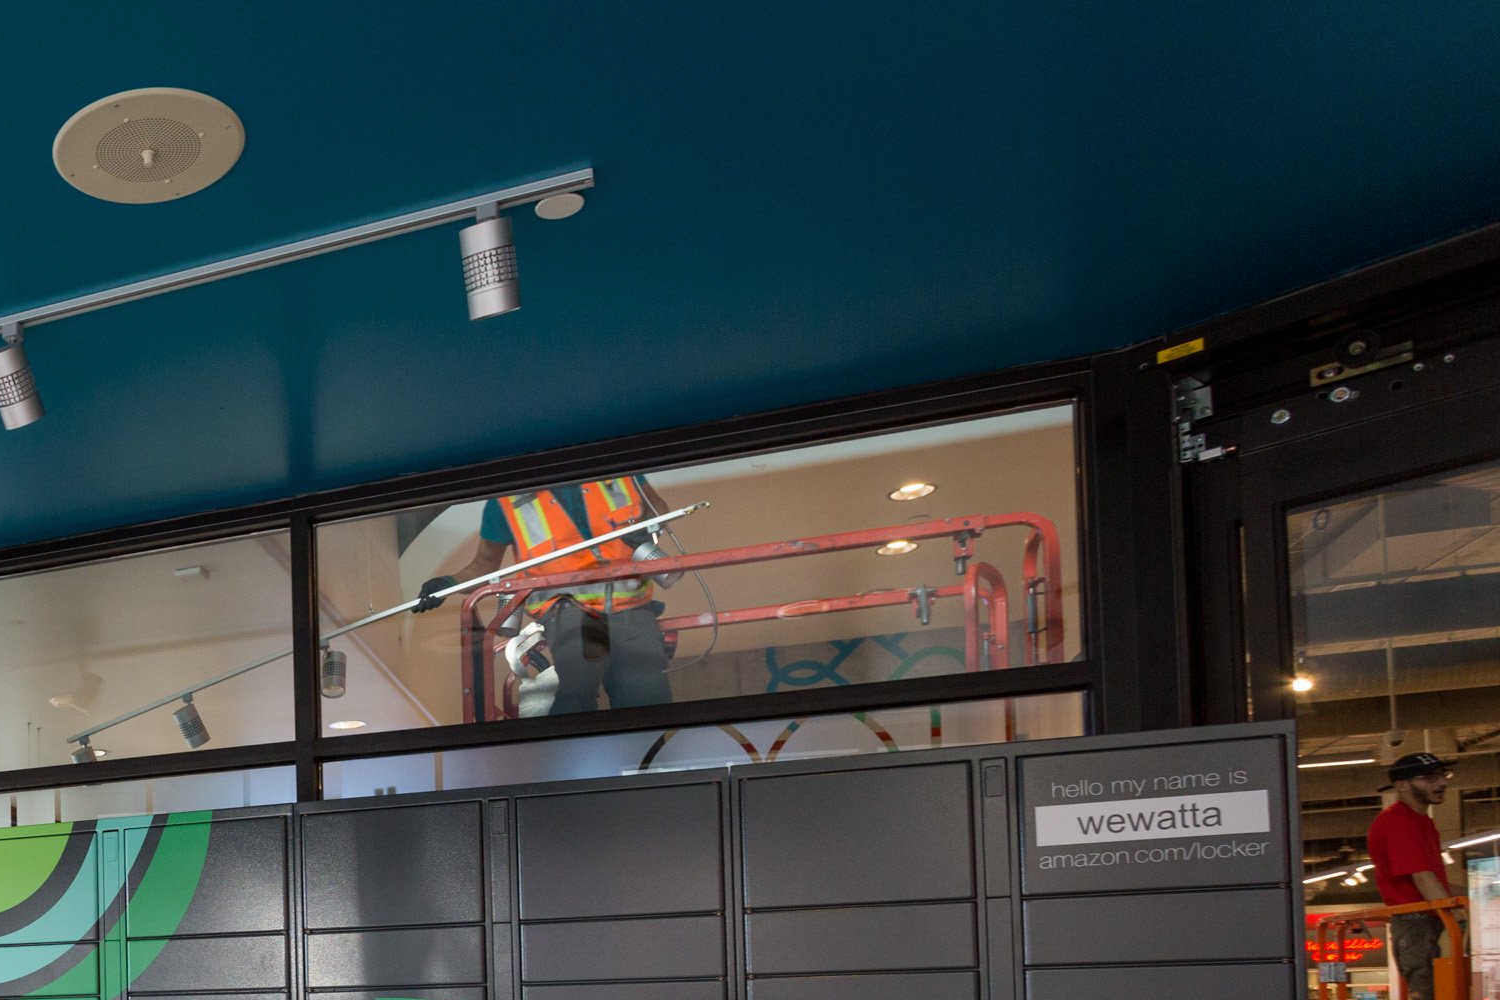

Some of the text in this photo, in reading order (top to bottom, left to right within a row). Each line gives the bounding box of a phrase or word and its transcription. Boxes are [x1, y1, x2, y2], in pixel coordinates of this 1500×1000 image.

[1051, 768, 1248, 798] hello my name is
[1077, 803, 1222, 835] wewatta
[1039, 841, 1270, 870] amazon.com/locker
